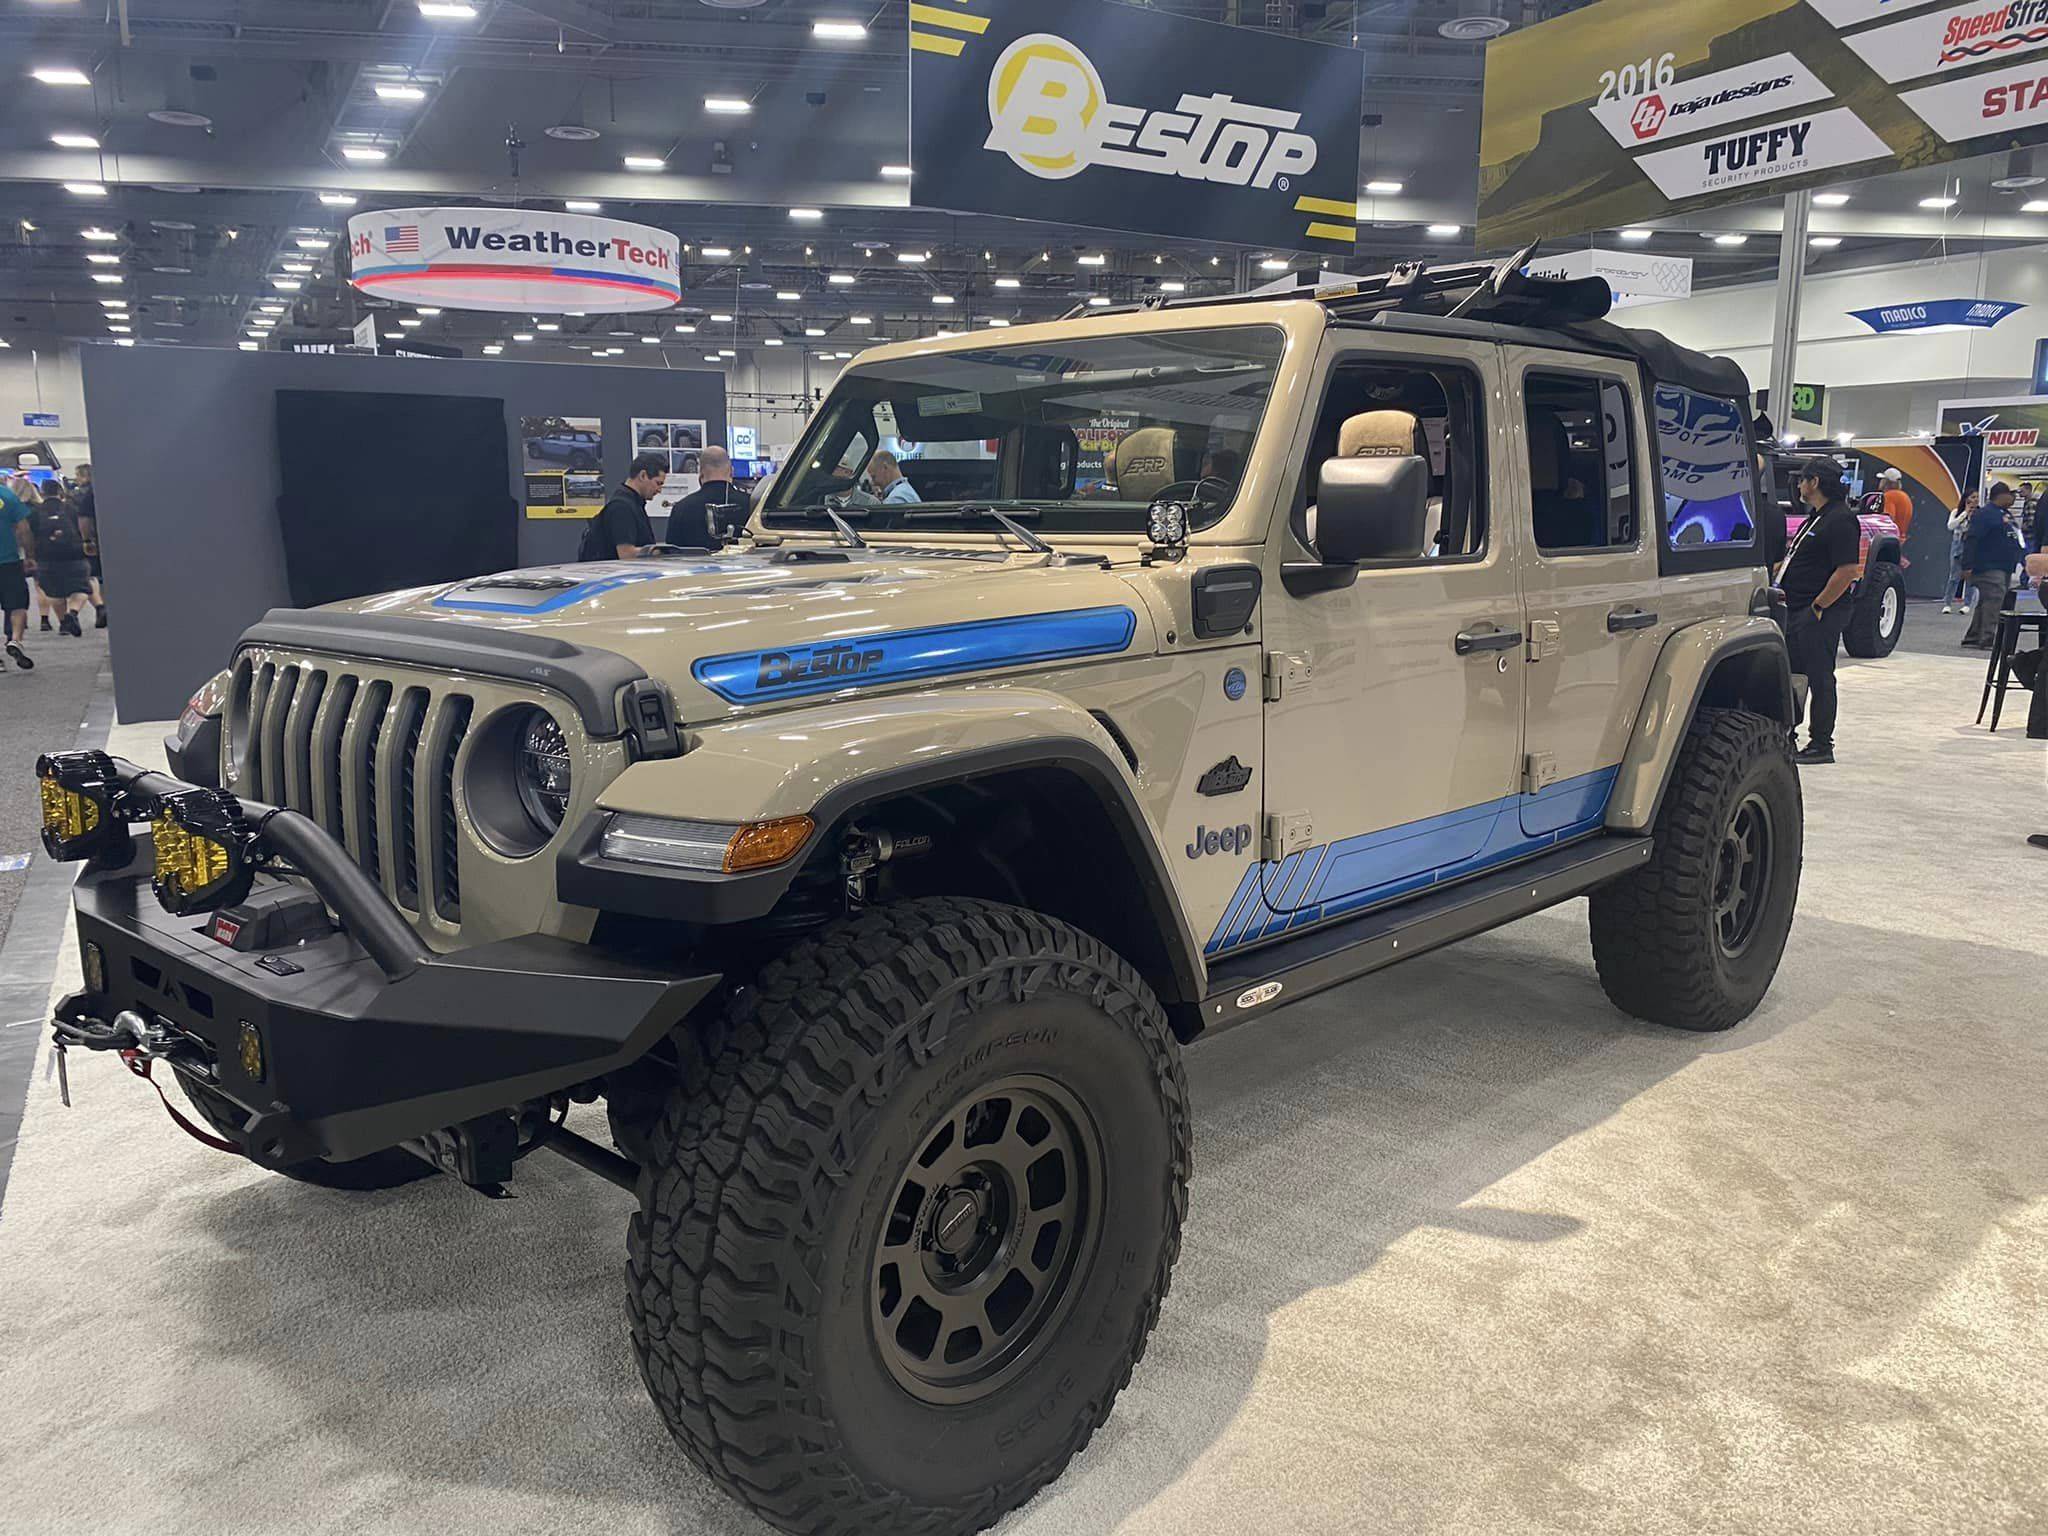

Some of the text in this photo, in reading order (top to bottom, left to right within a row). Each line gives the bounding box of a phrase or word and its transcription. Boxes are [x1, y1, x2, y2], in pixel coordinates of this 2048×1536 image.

[1943, 0, 2048, 46] SpeedStra
[1598, 53, 1675, 101] 2016
[1704, 121, 1811, 175] TUFFY
[1702, 159, 1809, 188] SECURITY PRODUCTS
[444, 226, 669, 269] WeatherTech
[1880, 306, 1927, 323] MADICO
[1793, 386, 1815, 411] 3D
[1072, 428, 1131, 441] ALIFOR
[1984, 429, 2037, 446] NIUM
[1076, 460, 1102, 468] oducts
[1986, 453, 2048, 467] Carbon Fi
[1186, 823, 1251, 860] Jeep
